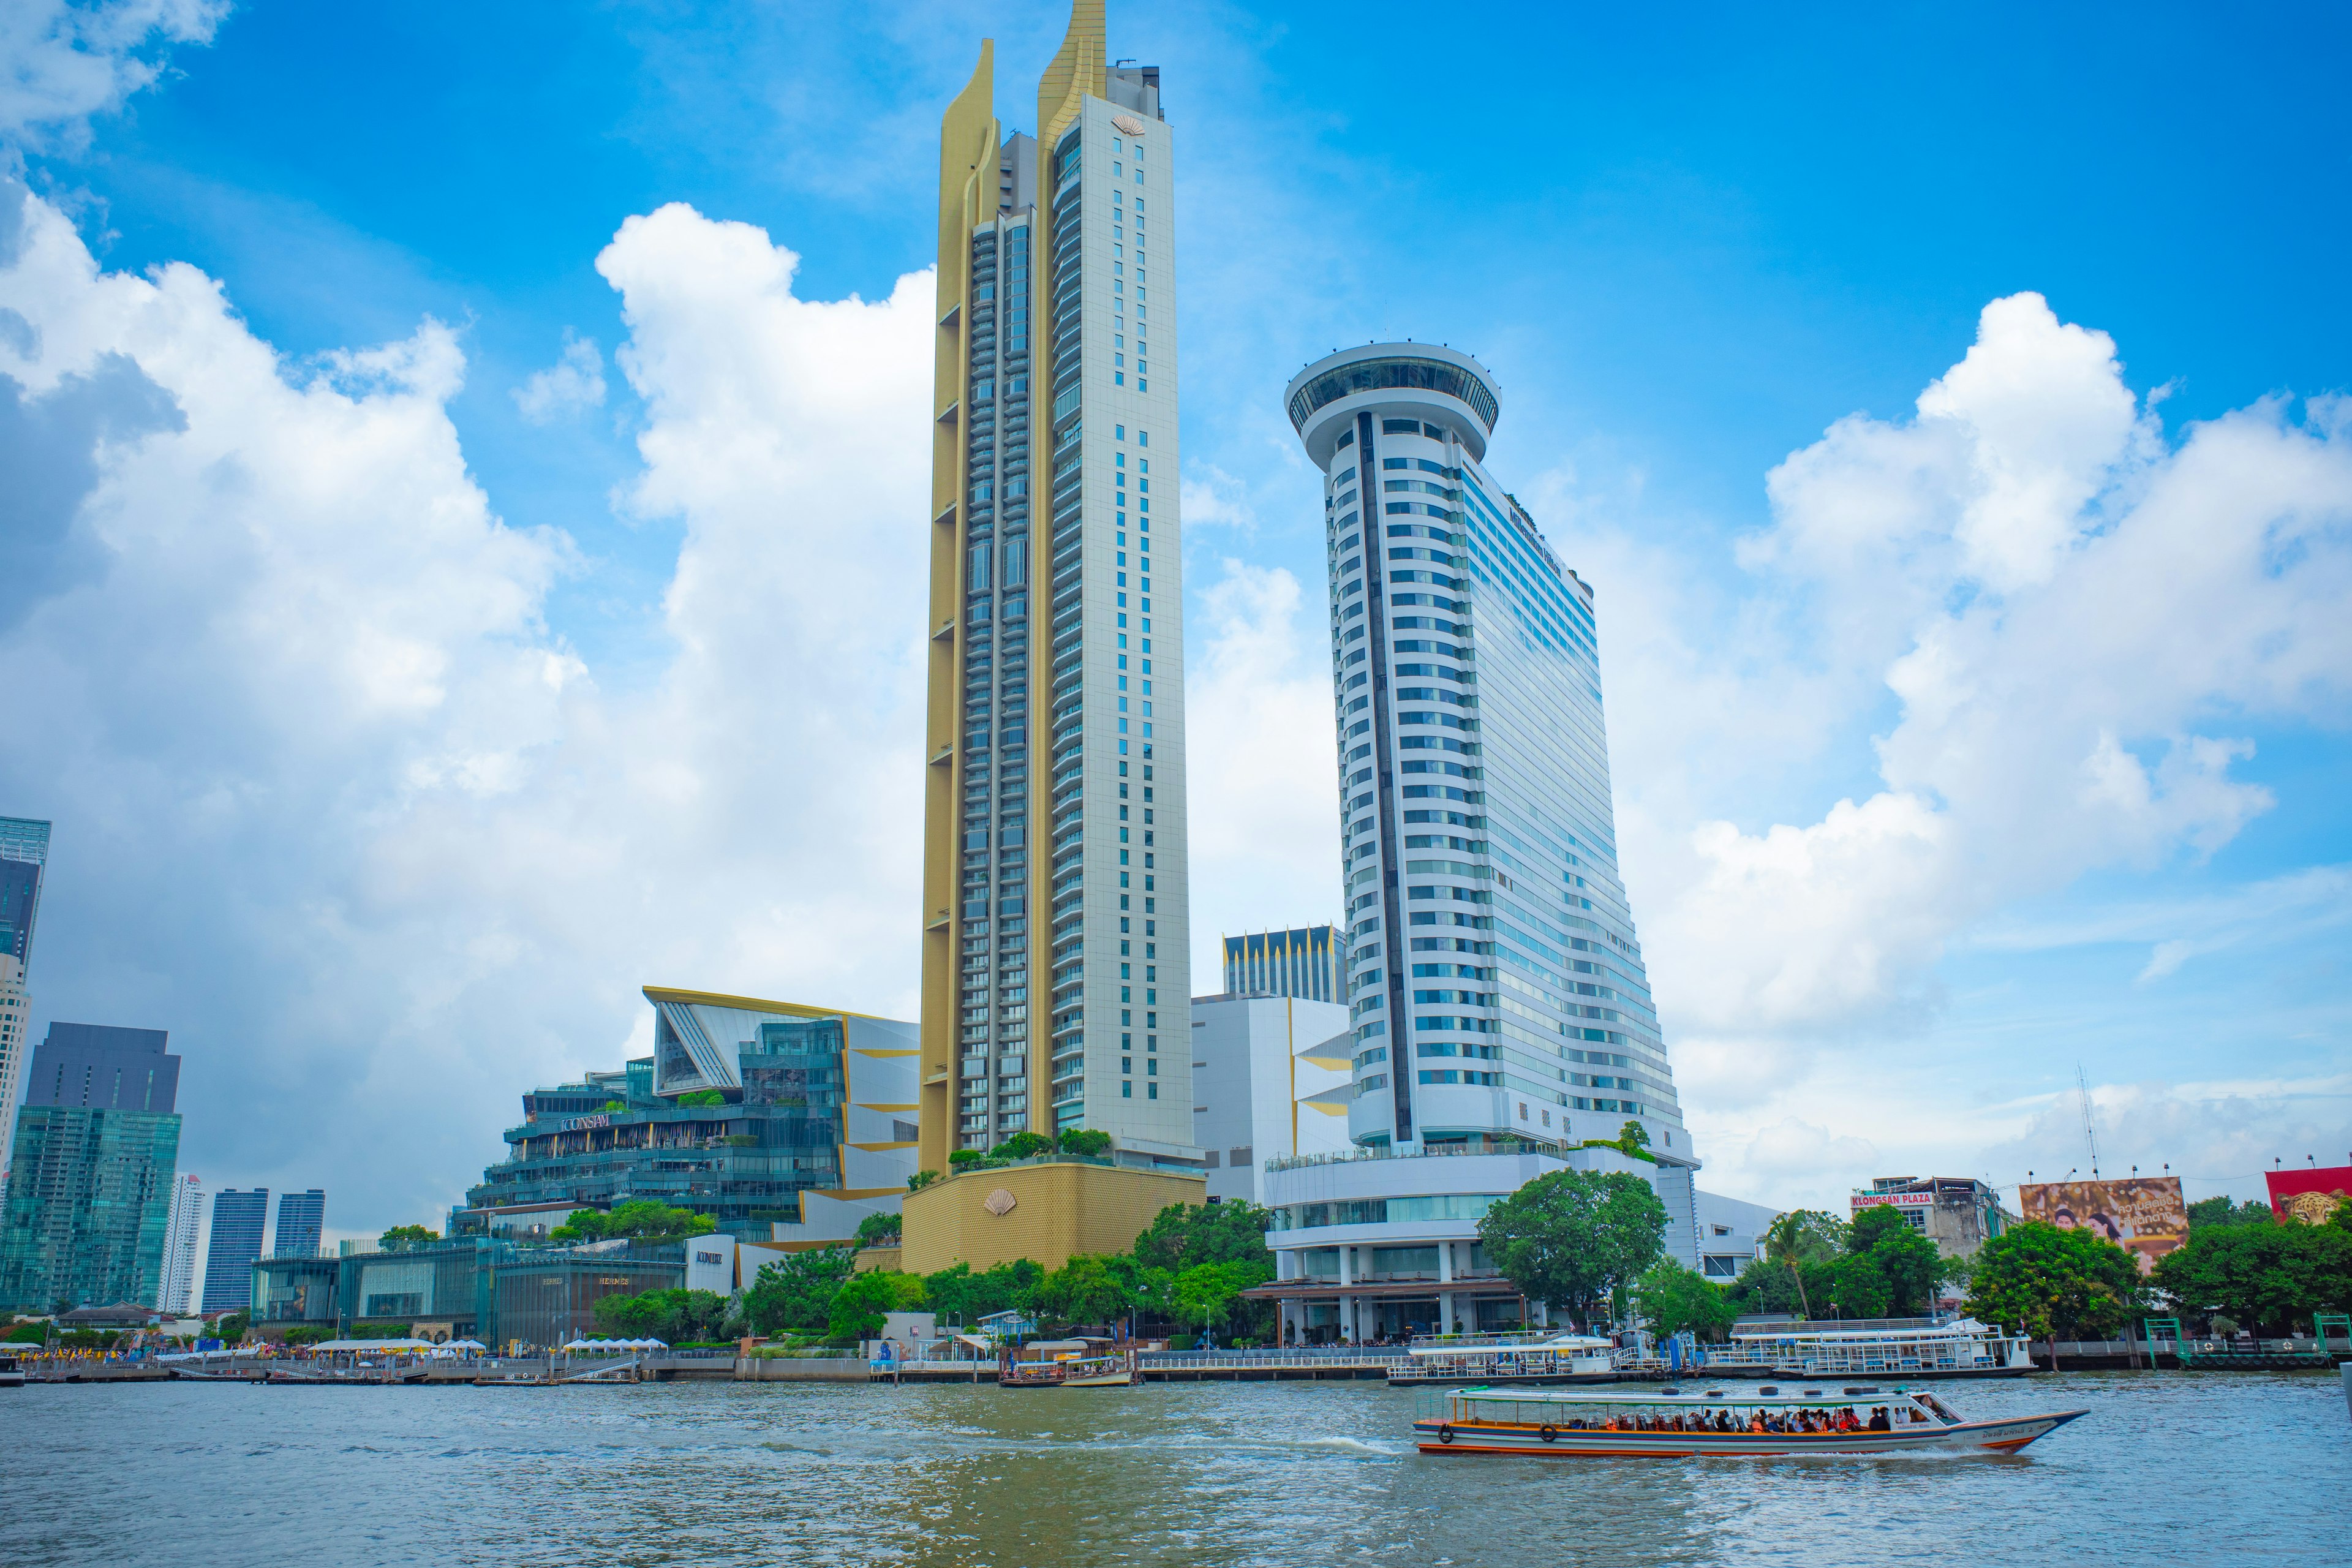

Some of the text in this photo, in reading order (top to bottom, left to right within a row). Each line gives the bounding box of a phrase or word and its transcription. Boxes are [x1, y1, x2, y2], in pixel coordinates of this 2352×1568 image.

[1509, 507, 1561, 579] Millennium Hilton
[561, 1114, 609, 1132] ICONSIAM
[1852, 1194, 1931, 1206] KLONGSAN PLAZA
[2118, 1194, 2174, 1214] ความสดชื่น
[2124, 1211, 2173, 1227] ที่แตกต่าง
